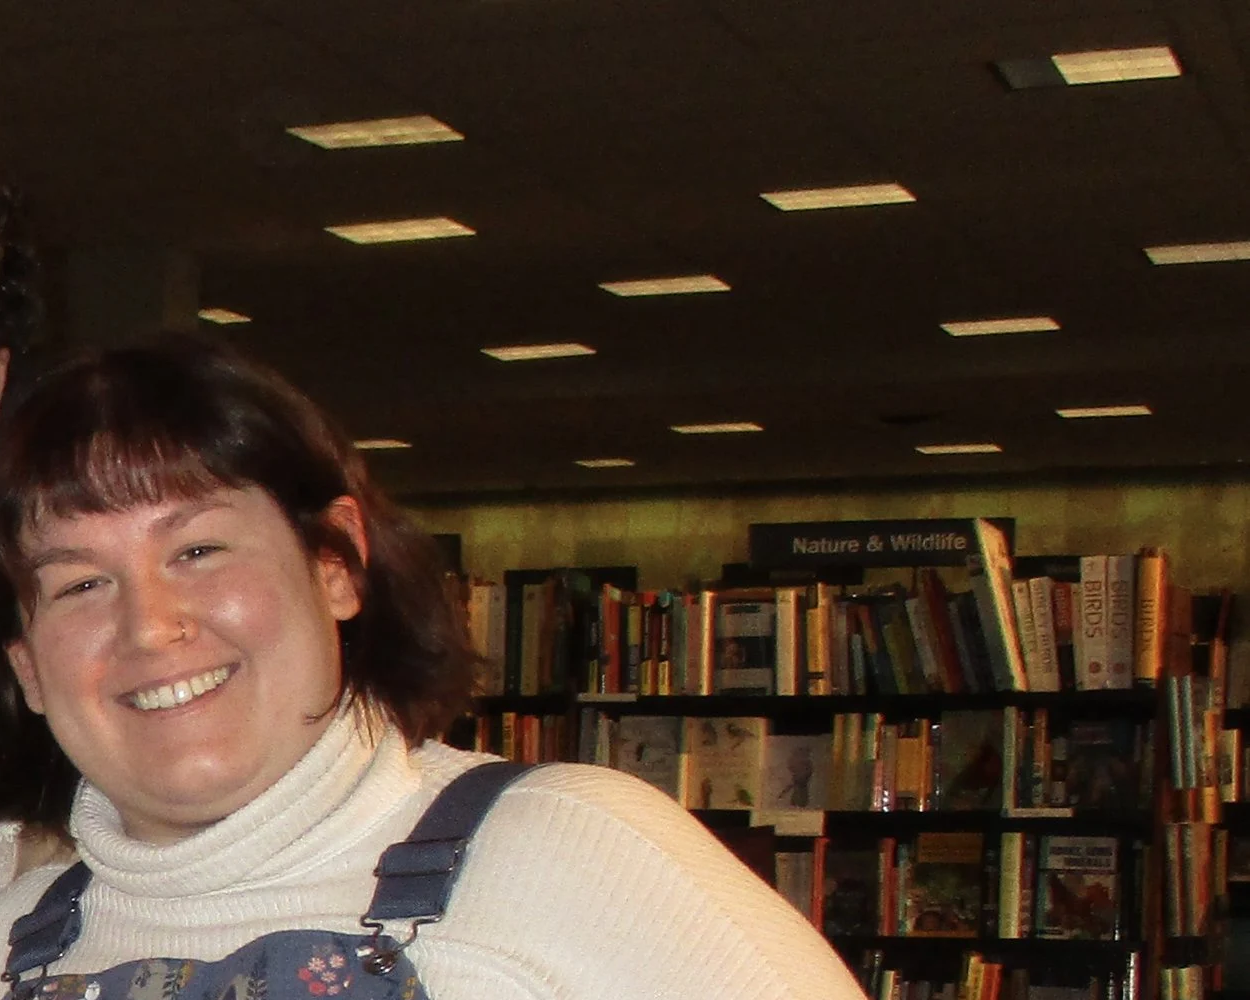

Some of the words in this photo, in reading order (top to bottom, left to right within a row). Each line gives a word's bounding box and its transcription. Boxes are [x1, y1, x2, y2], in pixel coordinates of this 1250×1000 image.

[792, 537, 860, 554] Nature
[866, 535, 882, 552] &
[890, 531, 967, 551] Wildlife
[1084, 580, 1103, 638] BIRDS
